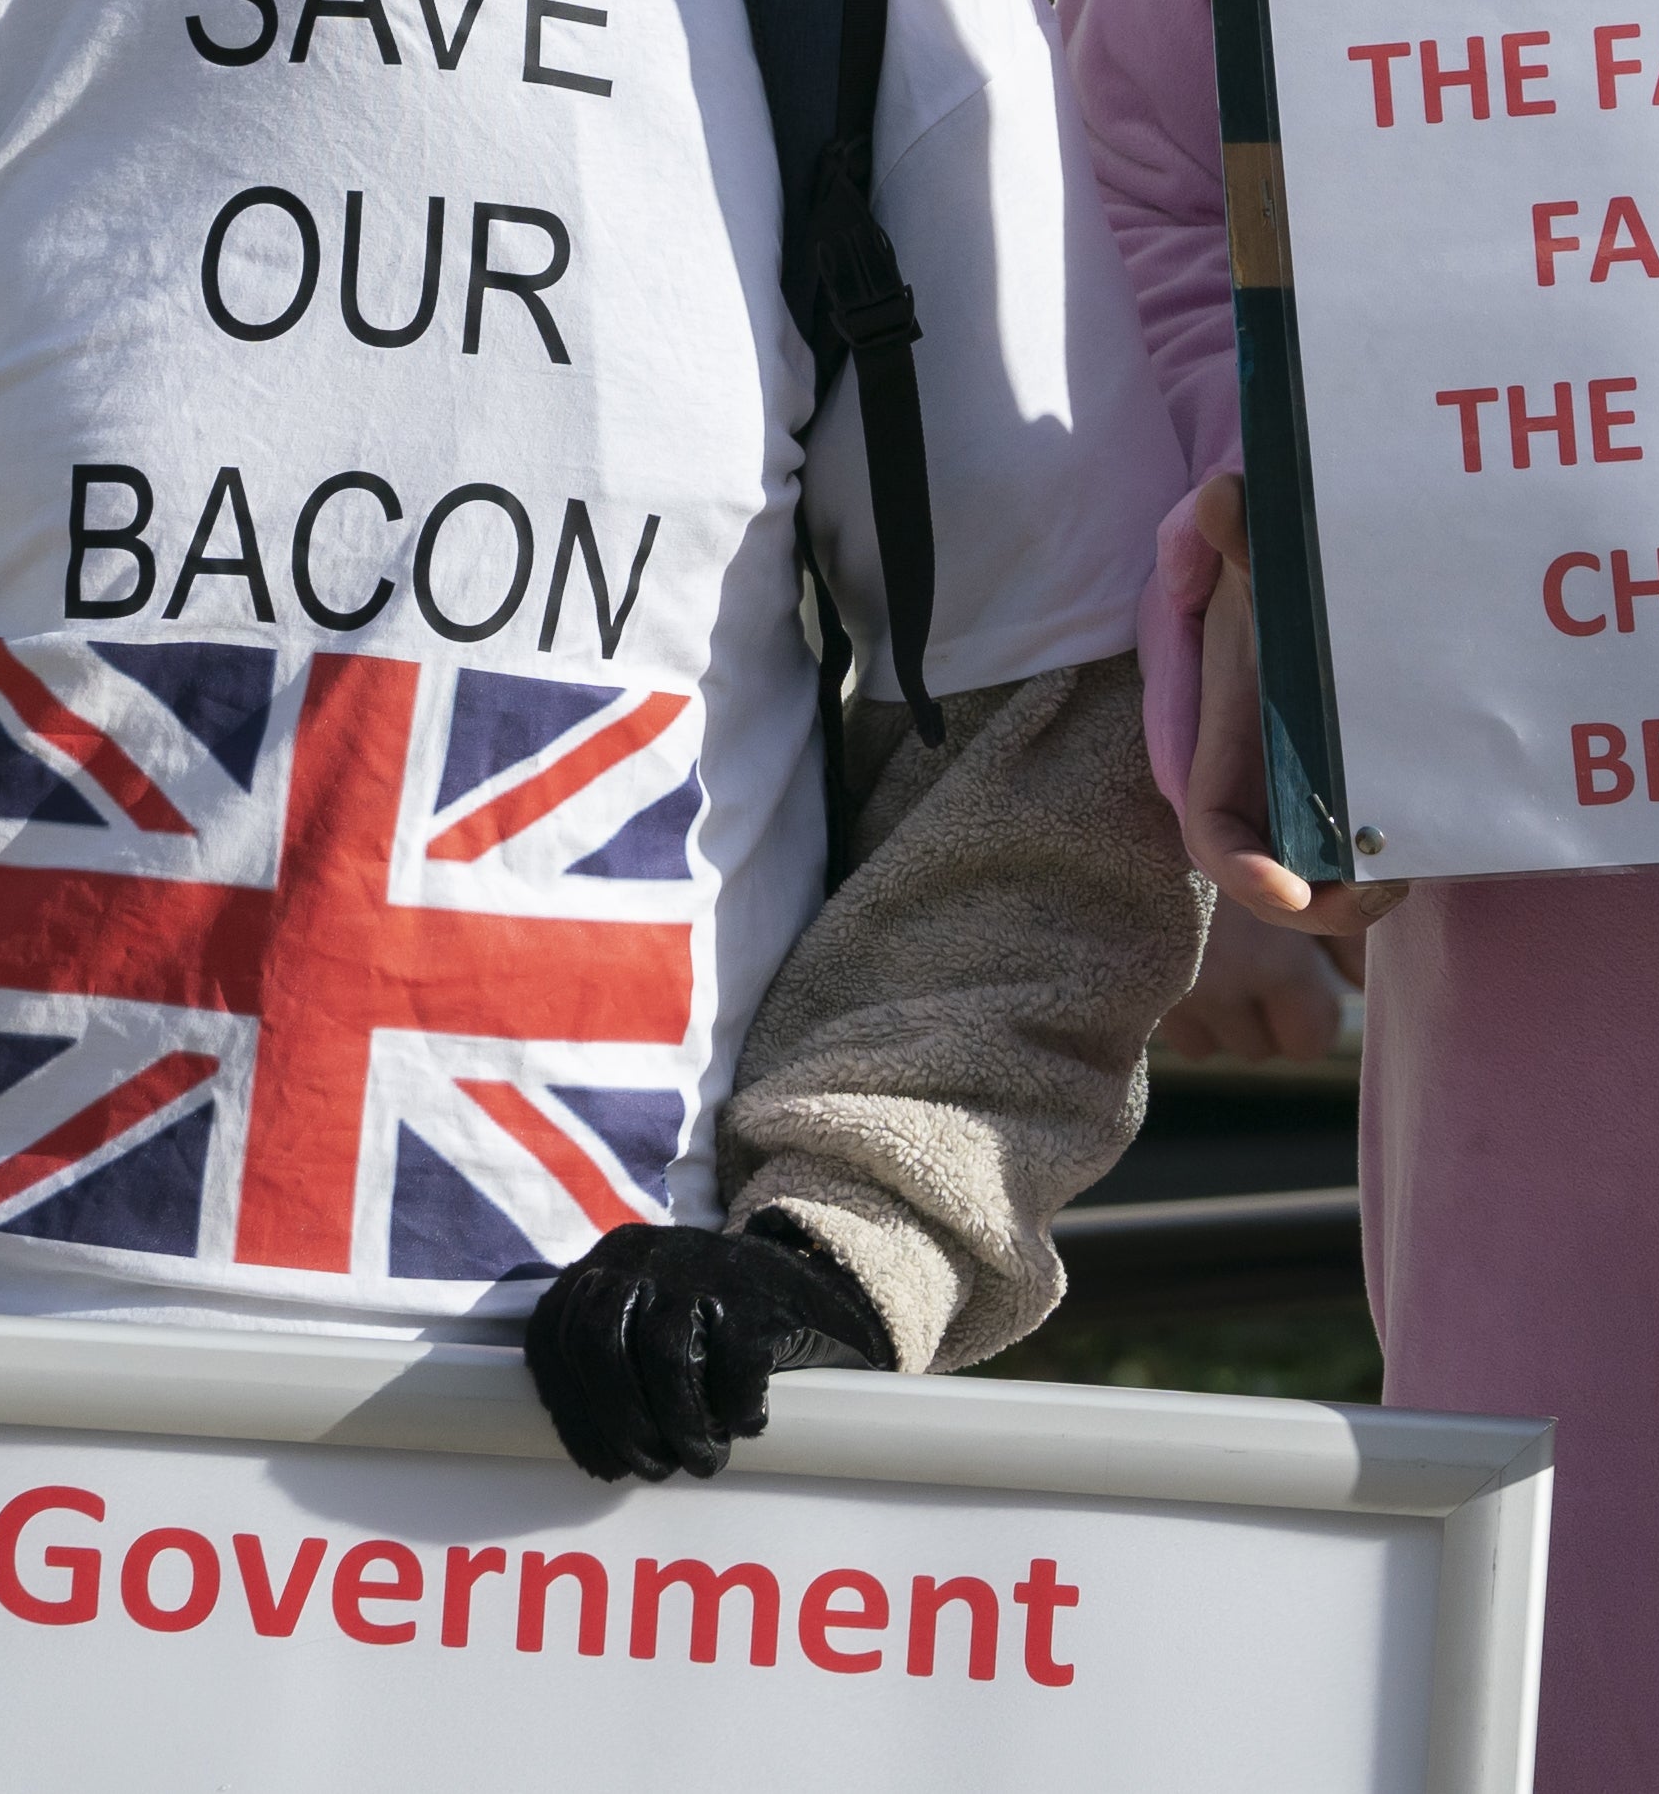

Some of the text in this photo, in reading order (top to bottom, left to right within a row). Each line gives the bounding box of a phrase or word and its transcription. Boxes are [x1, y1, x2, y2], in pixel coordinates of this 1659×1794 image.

[1348, 31, 1556, 128] THE
[201, 185, 572, 365] OUR
[1436, 378, 1642, 472] THE
[64, 463, 661, 660] BACON
